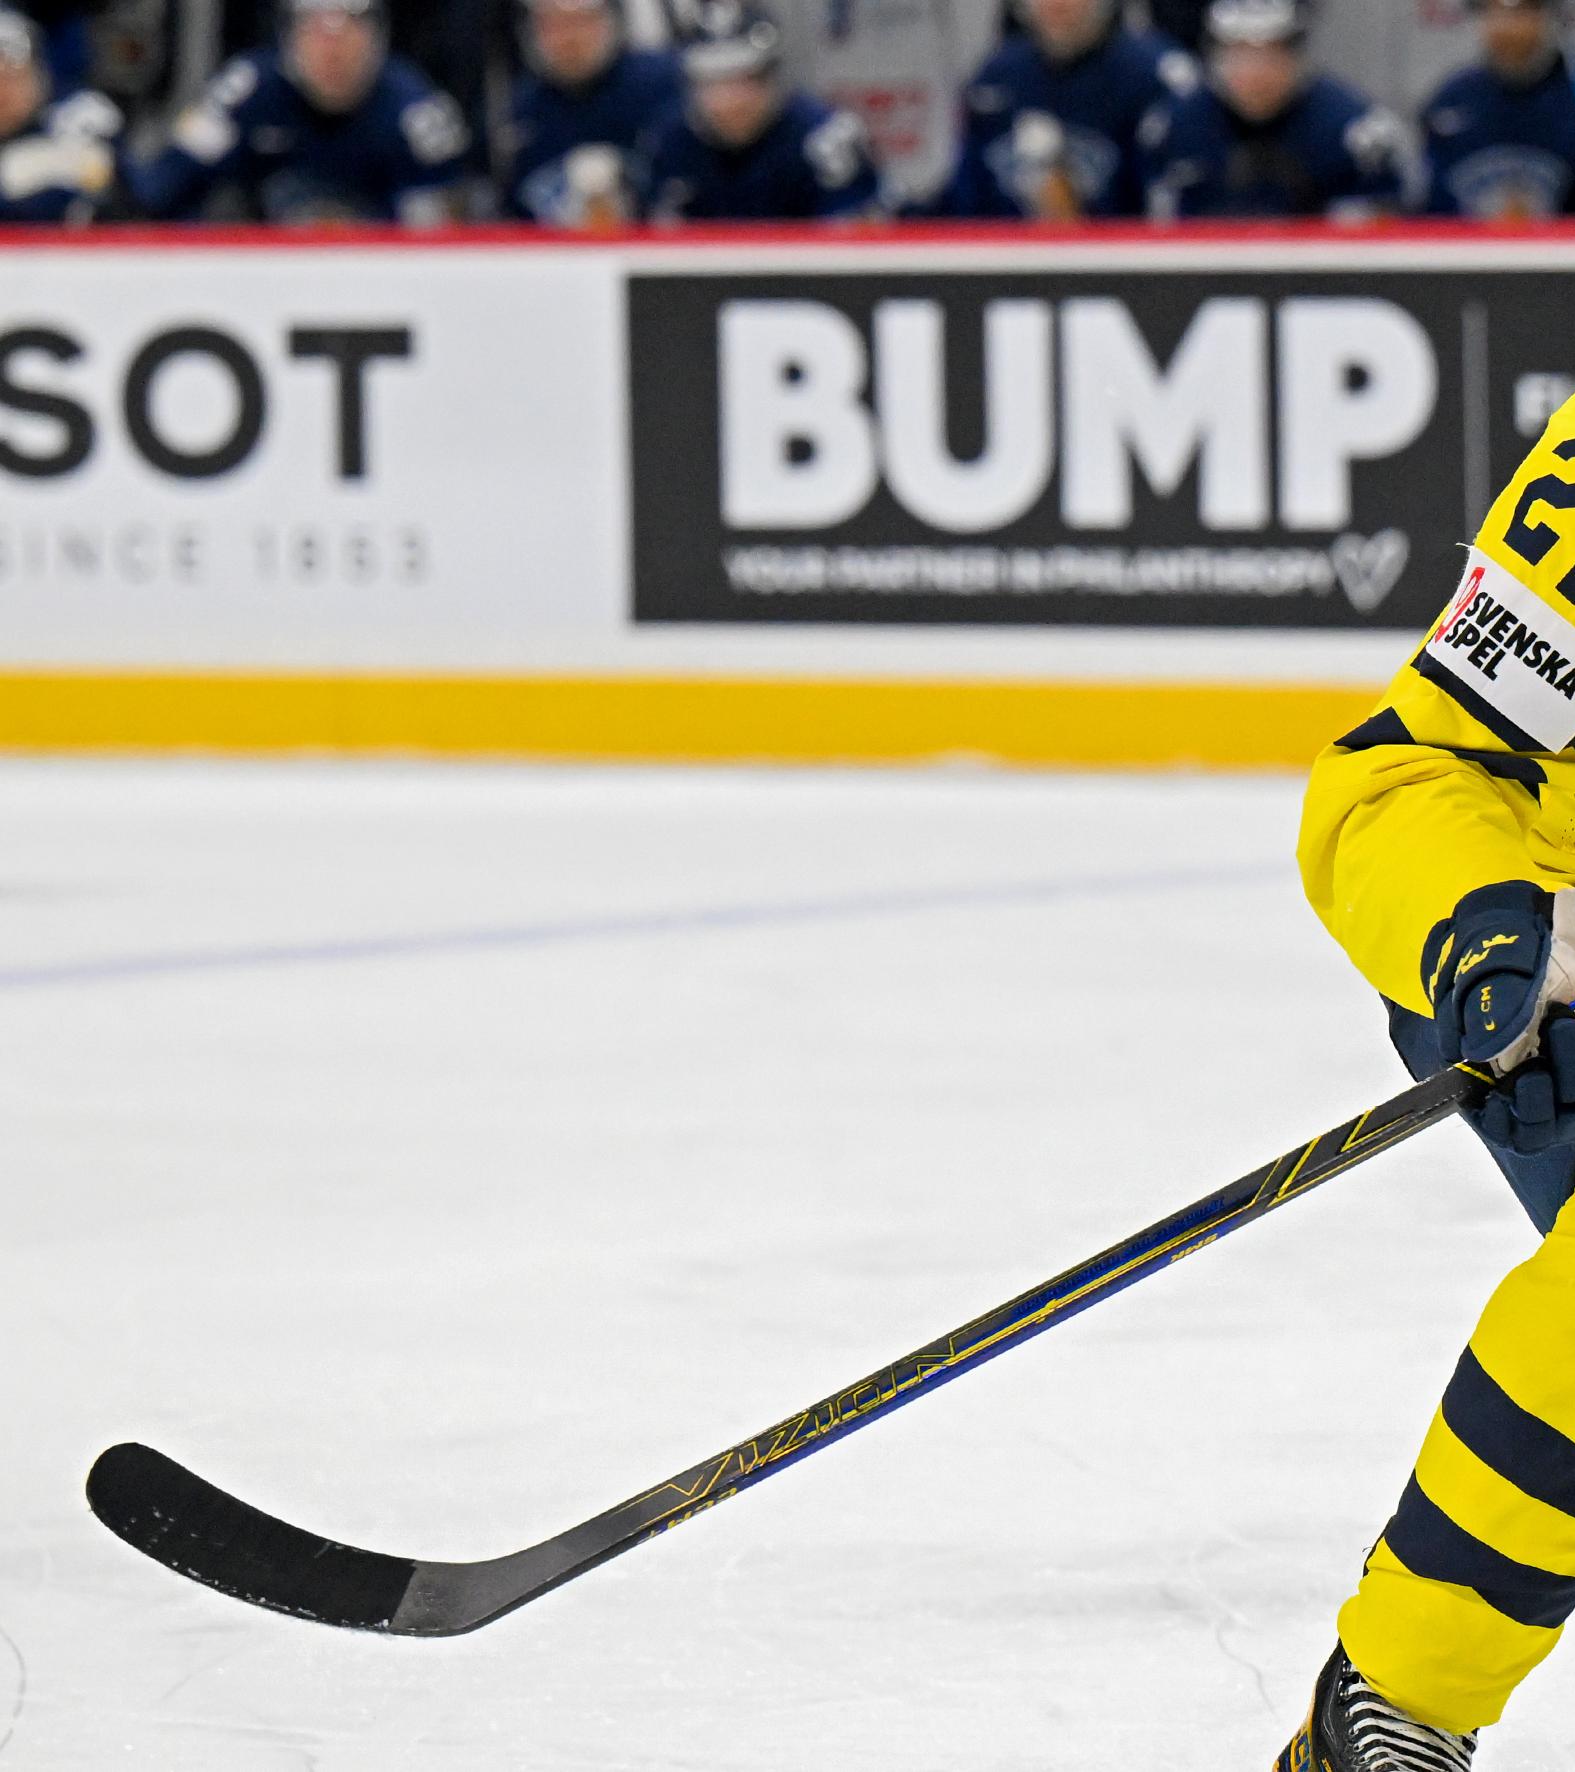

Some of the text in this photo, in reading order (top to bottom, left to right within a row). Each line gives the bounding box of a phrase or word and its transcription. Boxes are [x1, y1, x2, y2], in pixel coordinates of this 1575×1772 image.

[0, 324, 413, 481] SOT
[718, 297, 1439, 533] BUMP
[1445, 617, 1508, 682] SPEL
